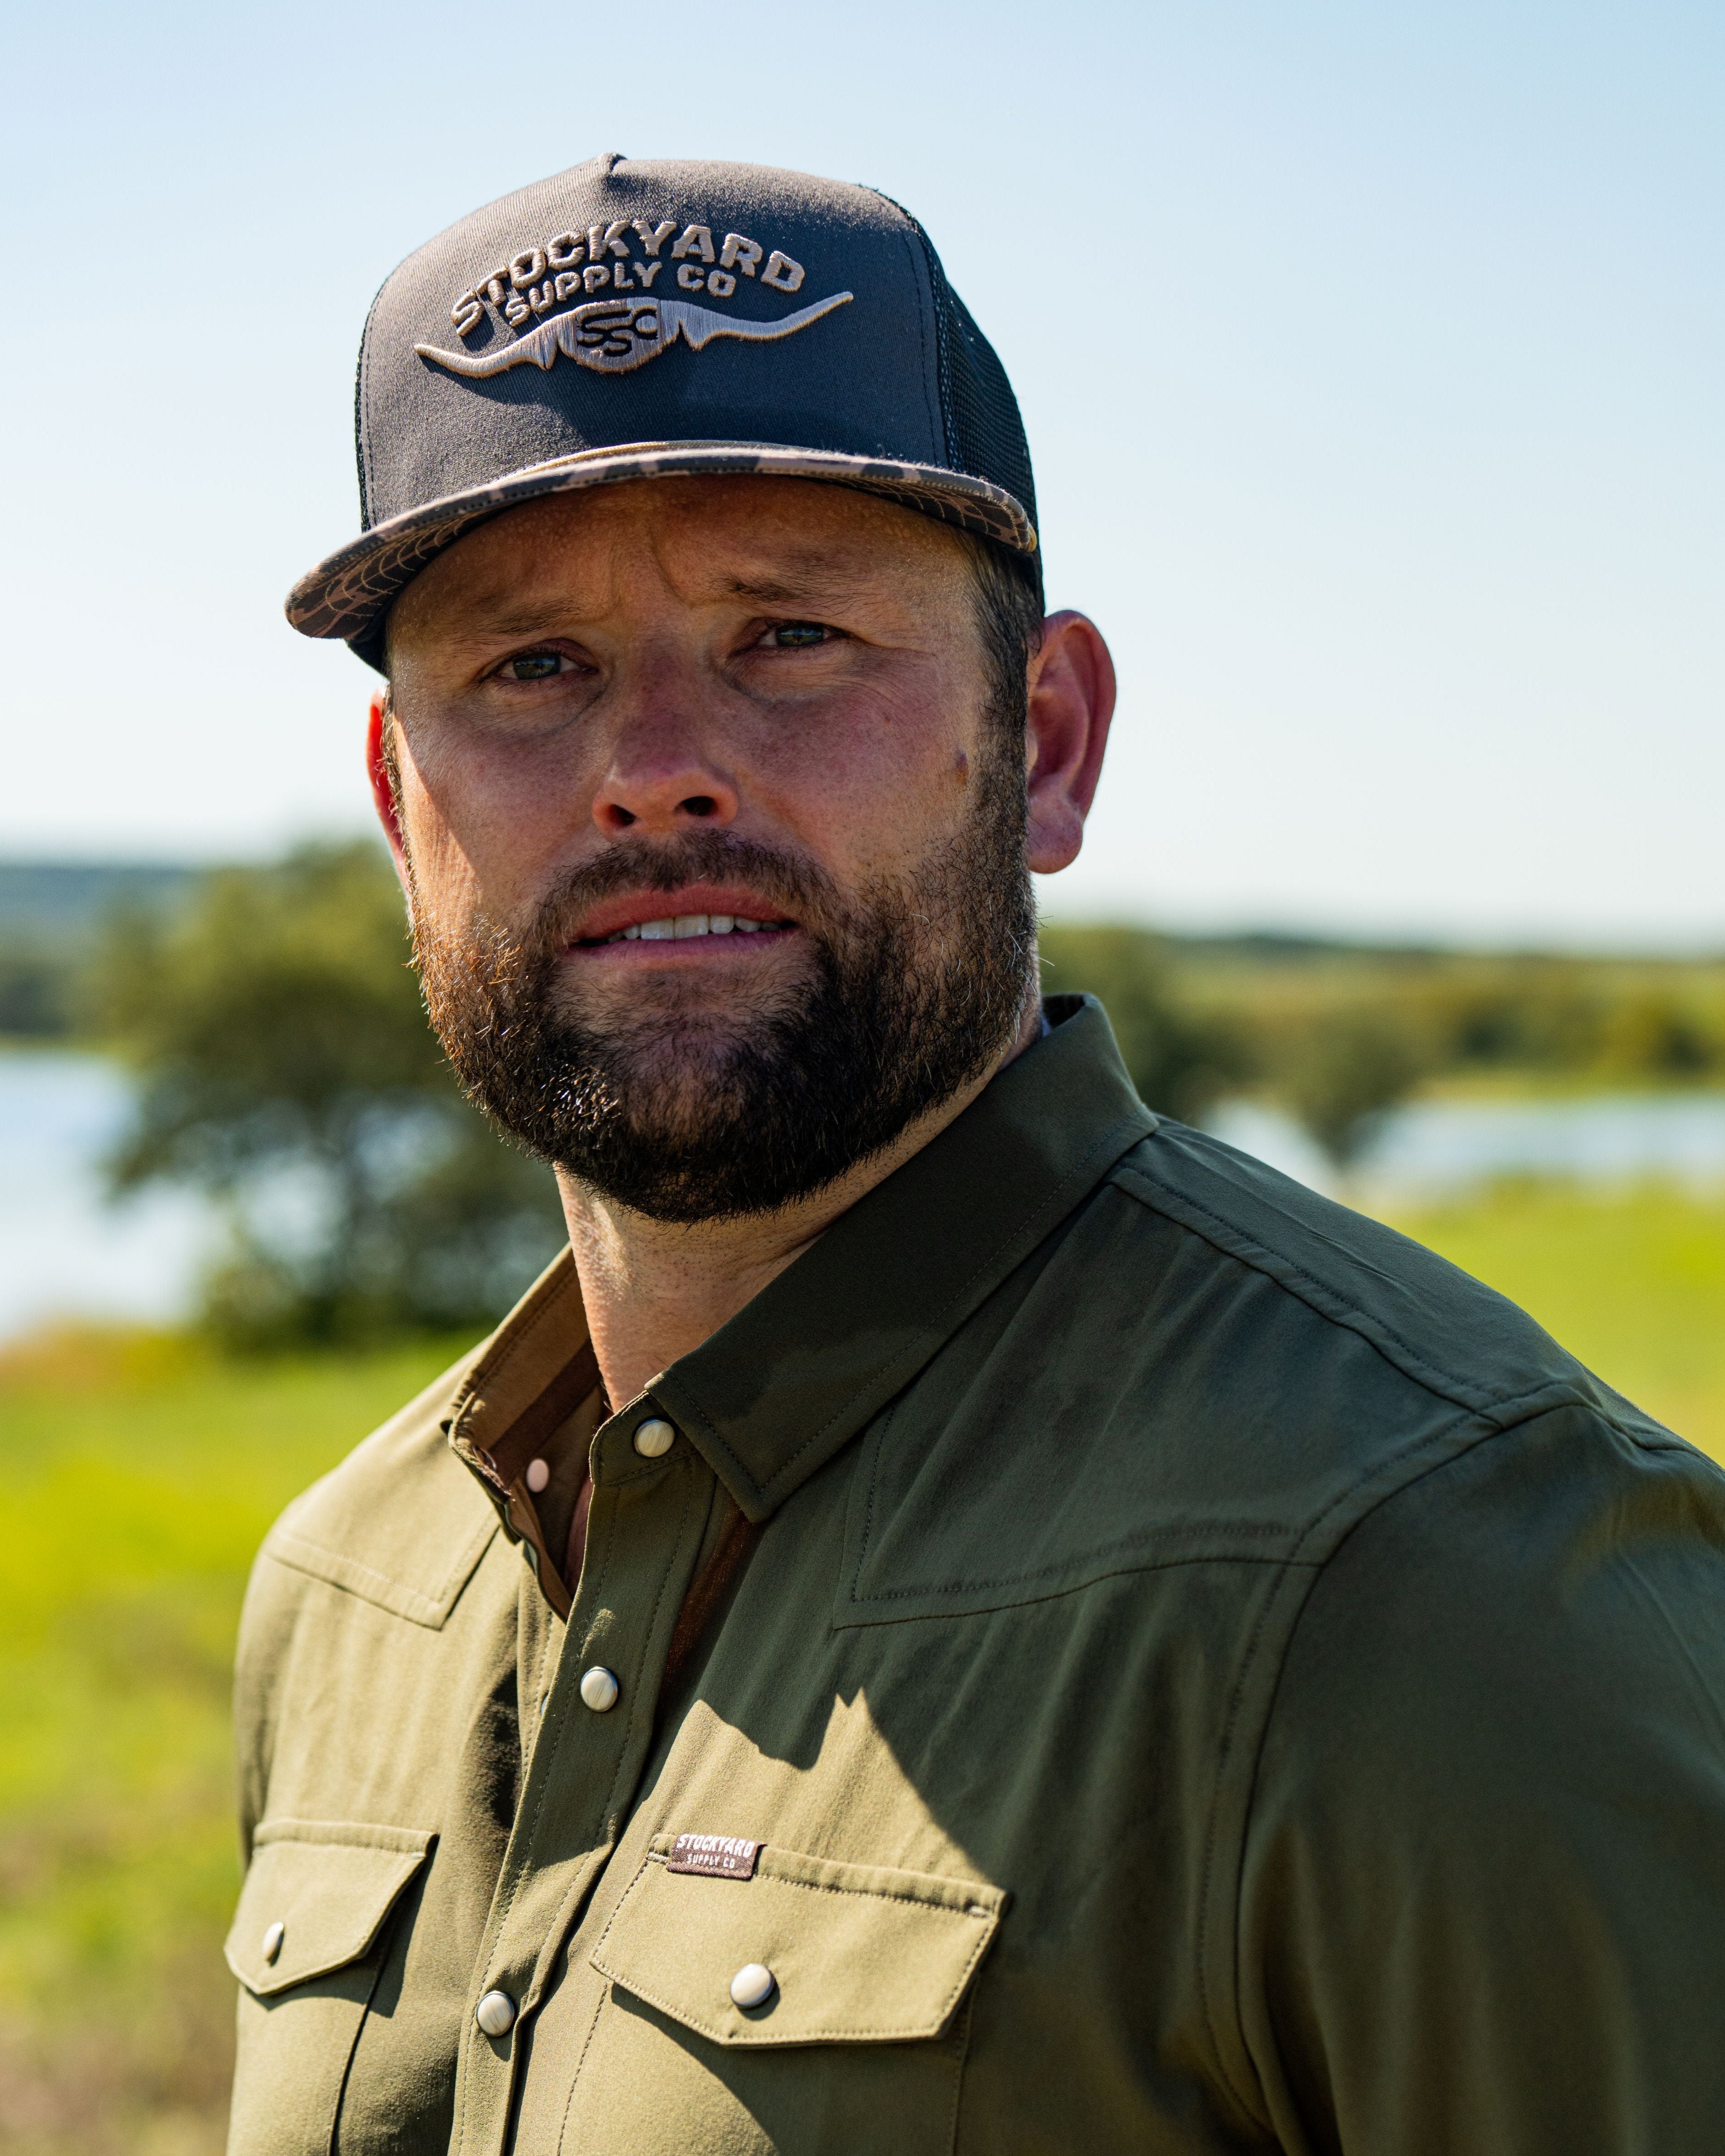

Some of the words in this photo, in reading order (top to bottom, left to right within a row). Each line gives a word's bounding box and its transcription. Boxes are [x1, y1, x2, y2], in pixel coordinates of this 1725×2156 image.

[451, 220, 805, 337] STOCKYARD
[505, 261, 662, 327] SUPPLY
[677, 263, 736, 298] CO
[676, 1833, 755, 1858] STOCKYARD
[686, 1853, 720, 1866] SUPPLY
[723, 1857, 736, 1869] CO
